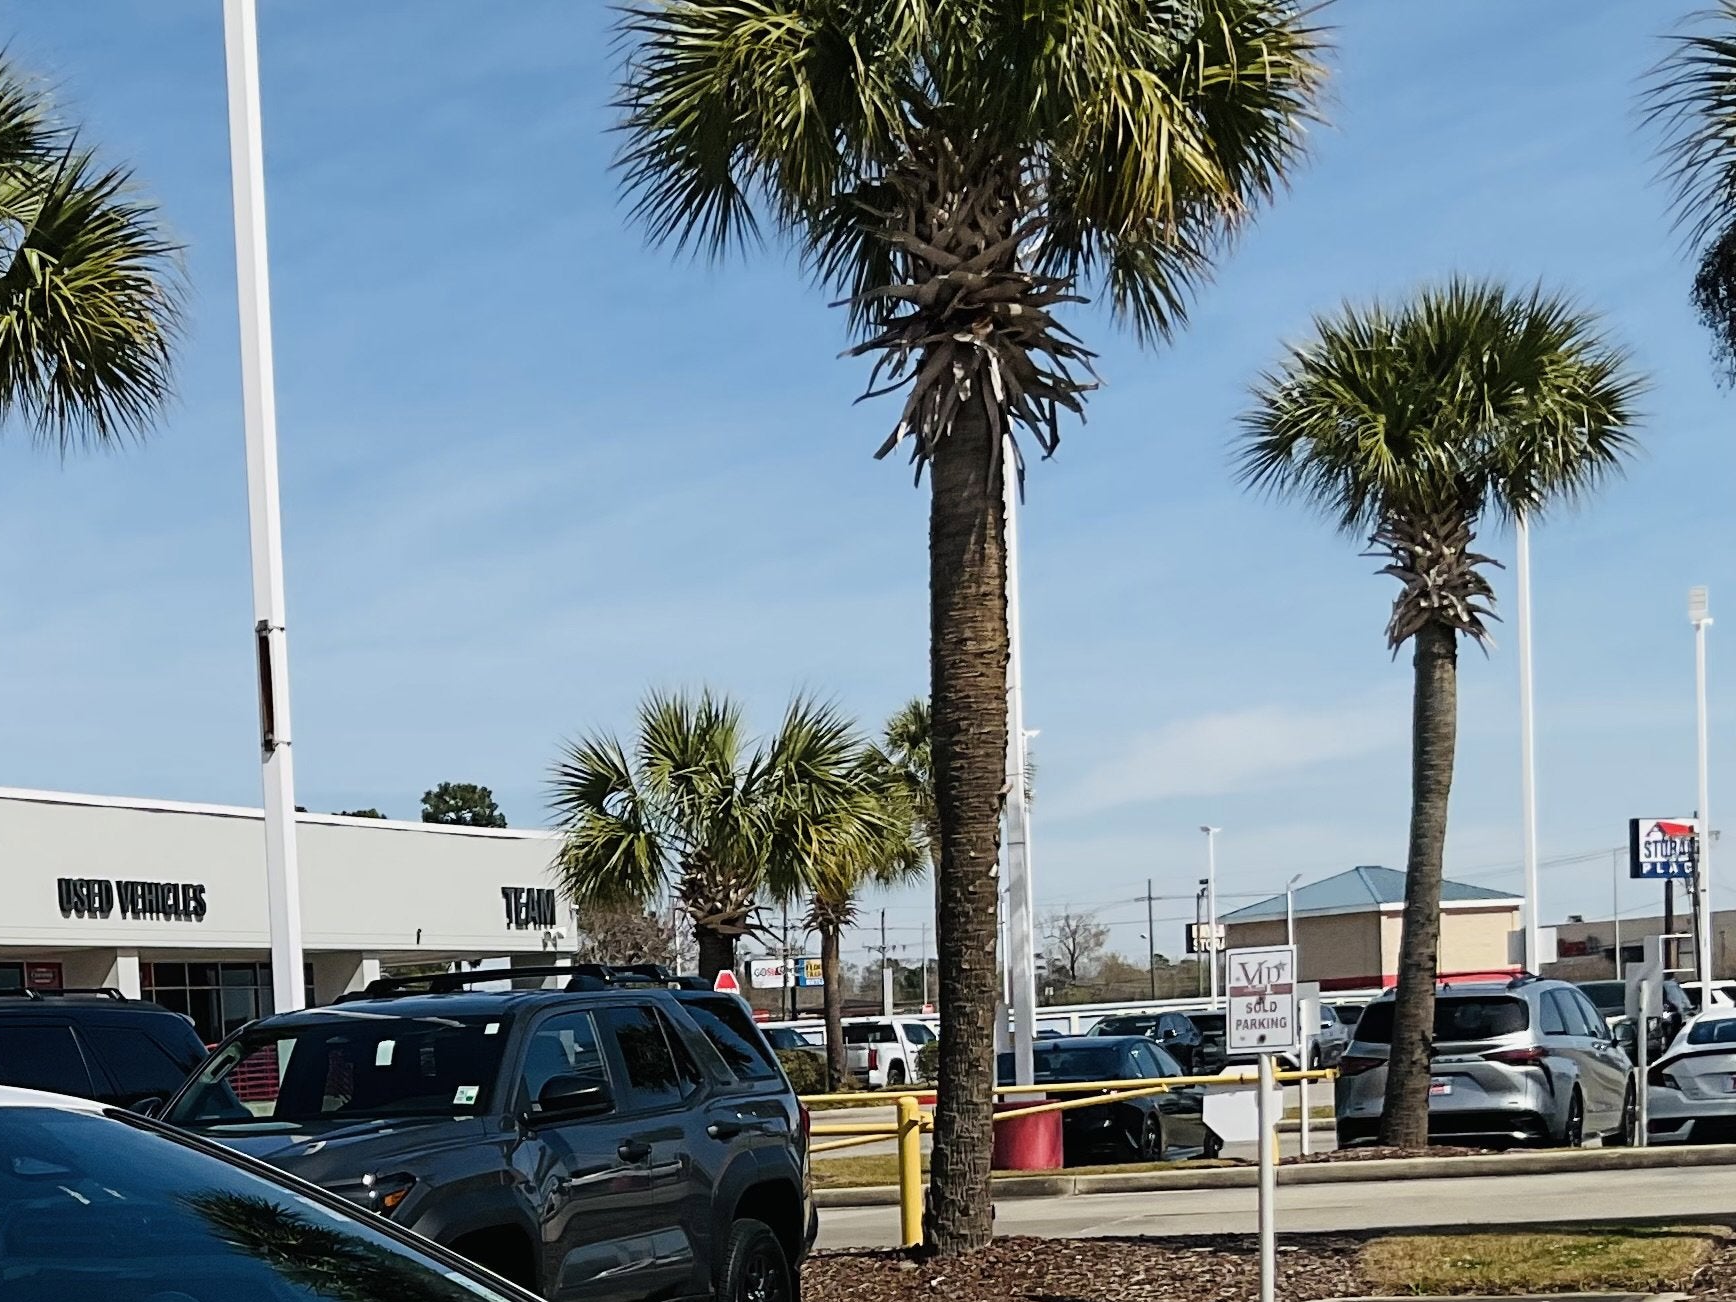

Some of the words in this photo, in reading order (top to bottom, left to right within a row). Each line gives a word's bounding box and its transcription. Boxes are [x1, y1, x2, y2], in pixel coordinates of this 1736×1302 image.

[1644, 838, 1700, 858] STORA
[1642, 861, 1694, 874] PLAC
[57, 878, 114, 915] USED
[115, 881, 207, 919] VEHICLES
[501, 886, 556, 927] TEAM
[1245, 1001, 1278, 1014] SOLD
[1236, 1017, 1287, 1030] PARKING
